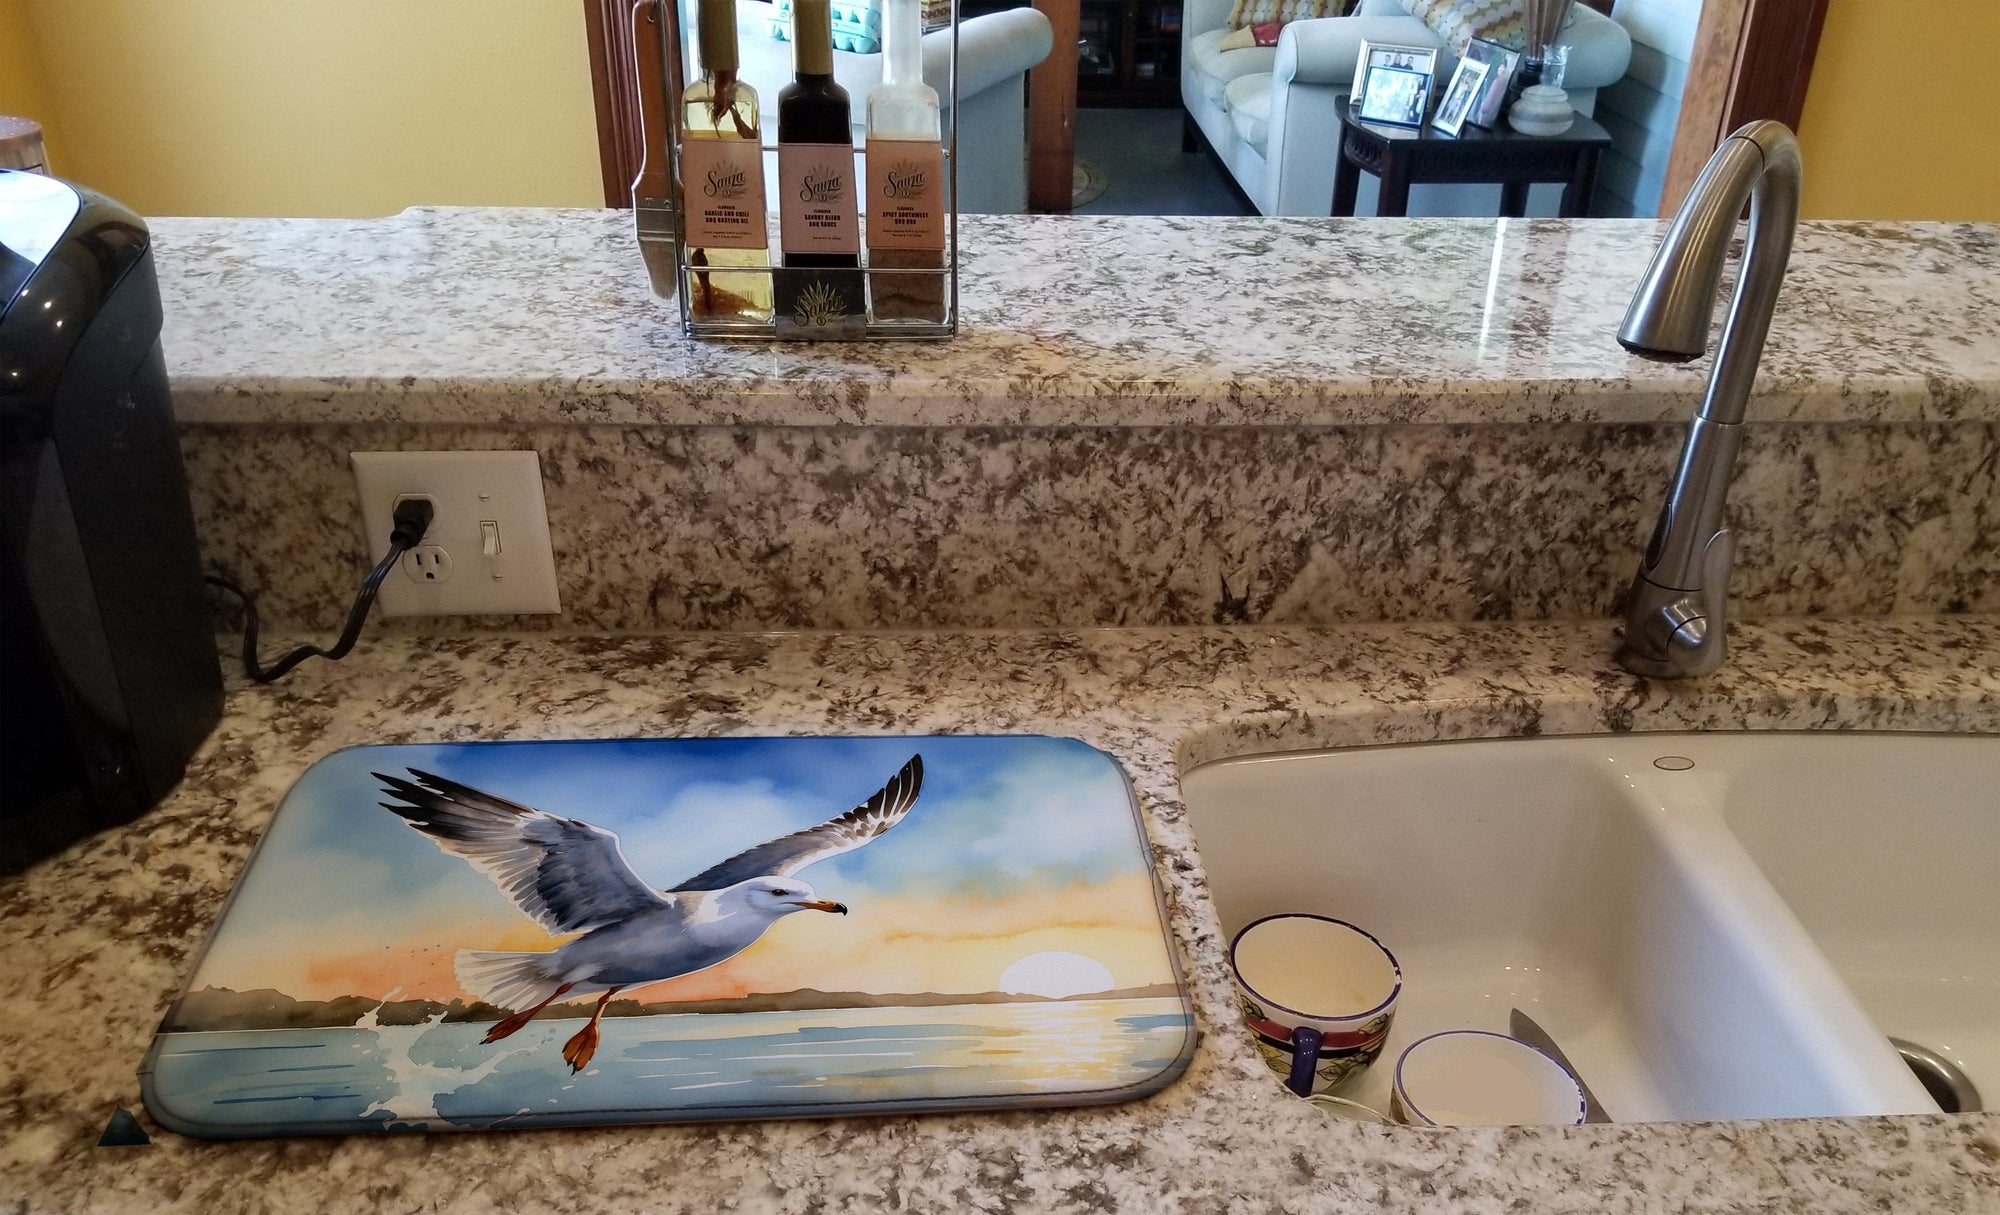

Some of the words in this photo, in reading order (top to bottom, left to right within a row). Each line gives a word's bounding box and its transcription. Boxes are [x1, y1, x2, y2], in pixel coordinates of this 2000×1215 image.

[703, 170, 746, 197] Sauza
[799, 175, 841, 202] Sauza
[883, 171, 925, 198] Sauza
